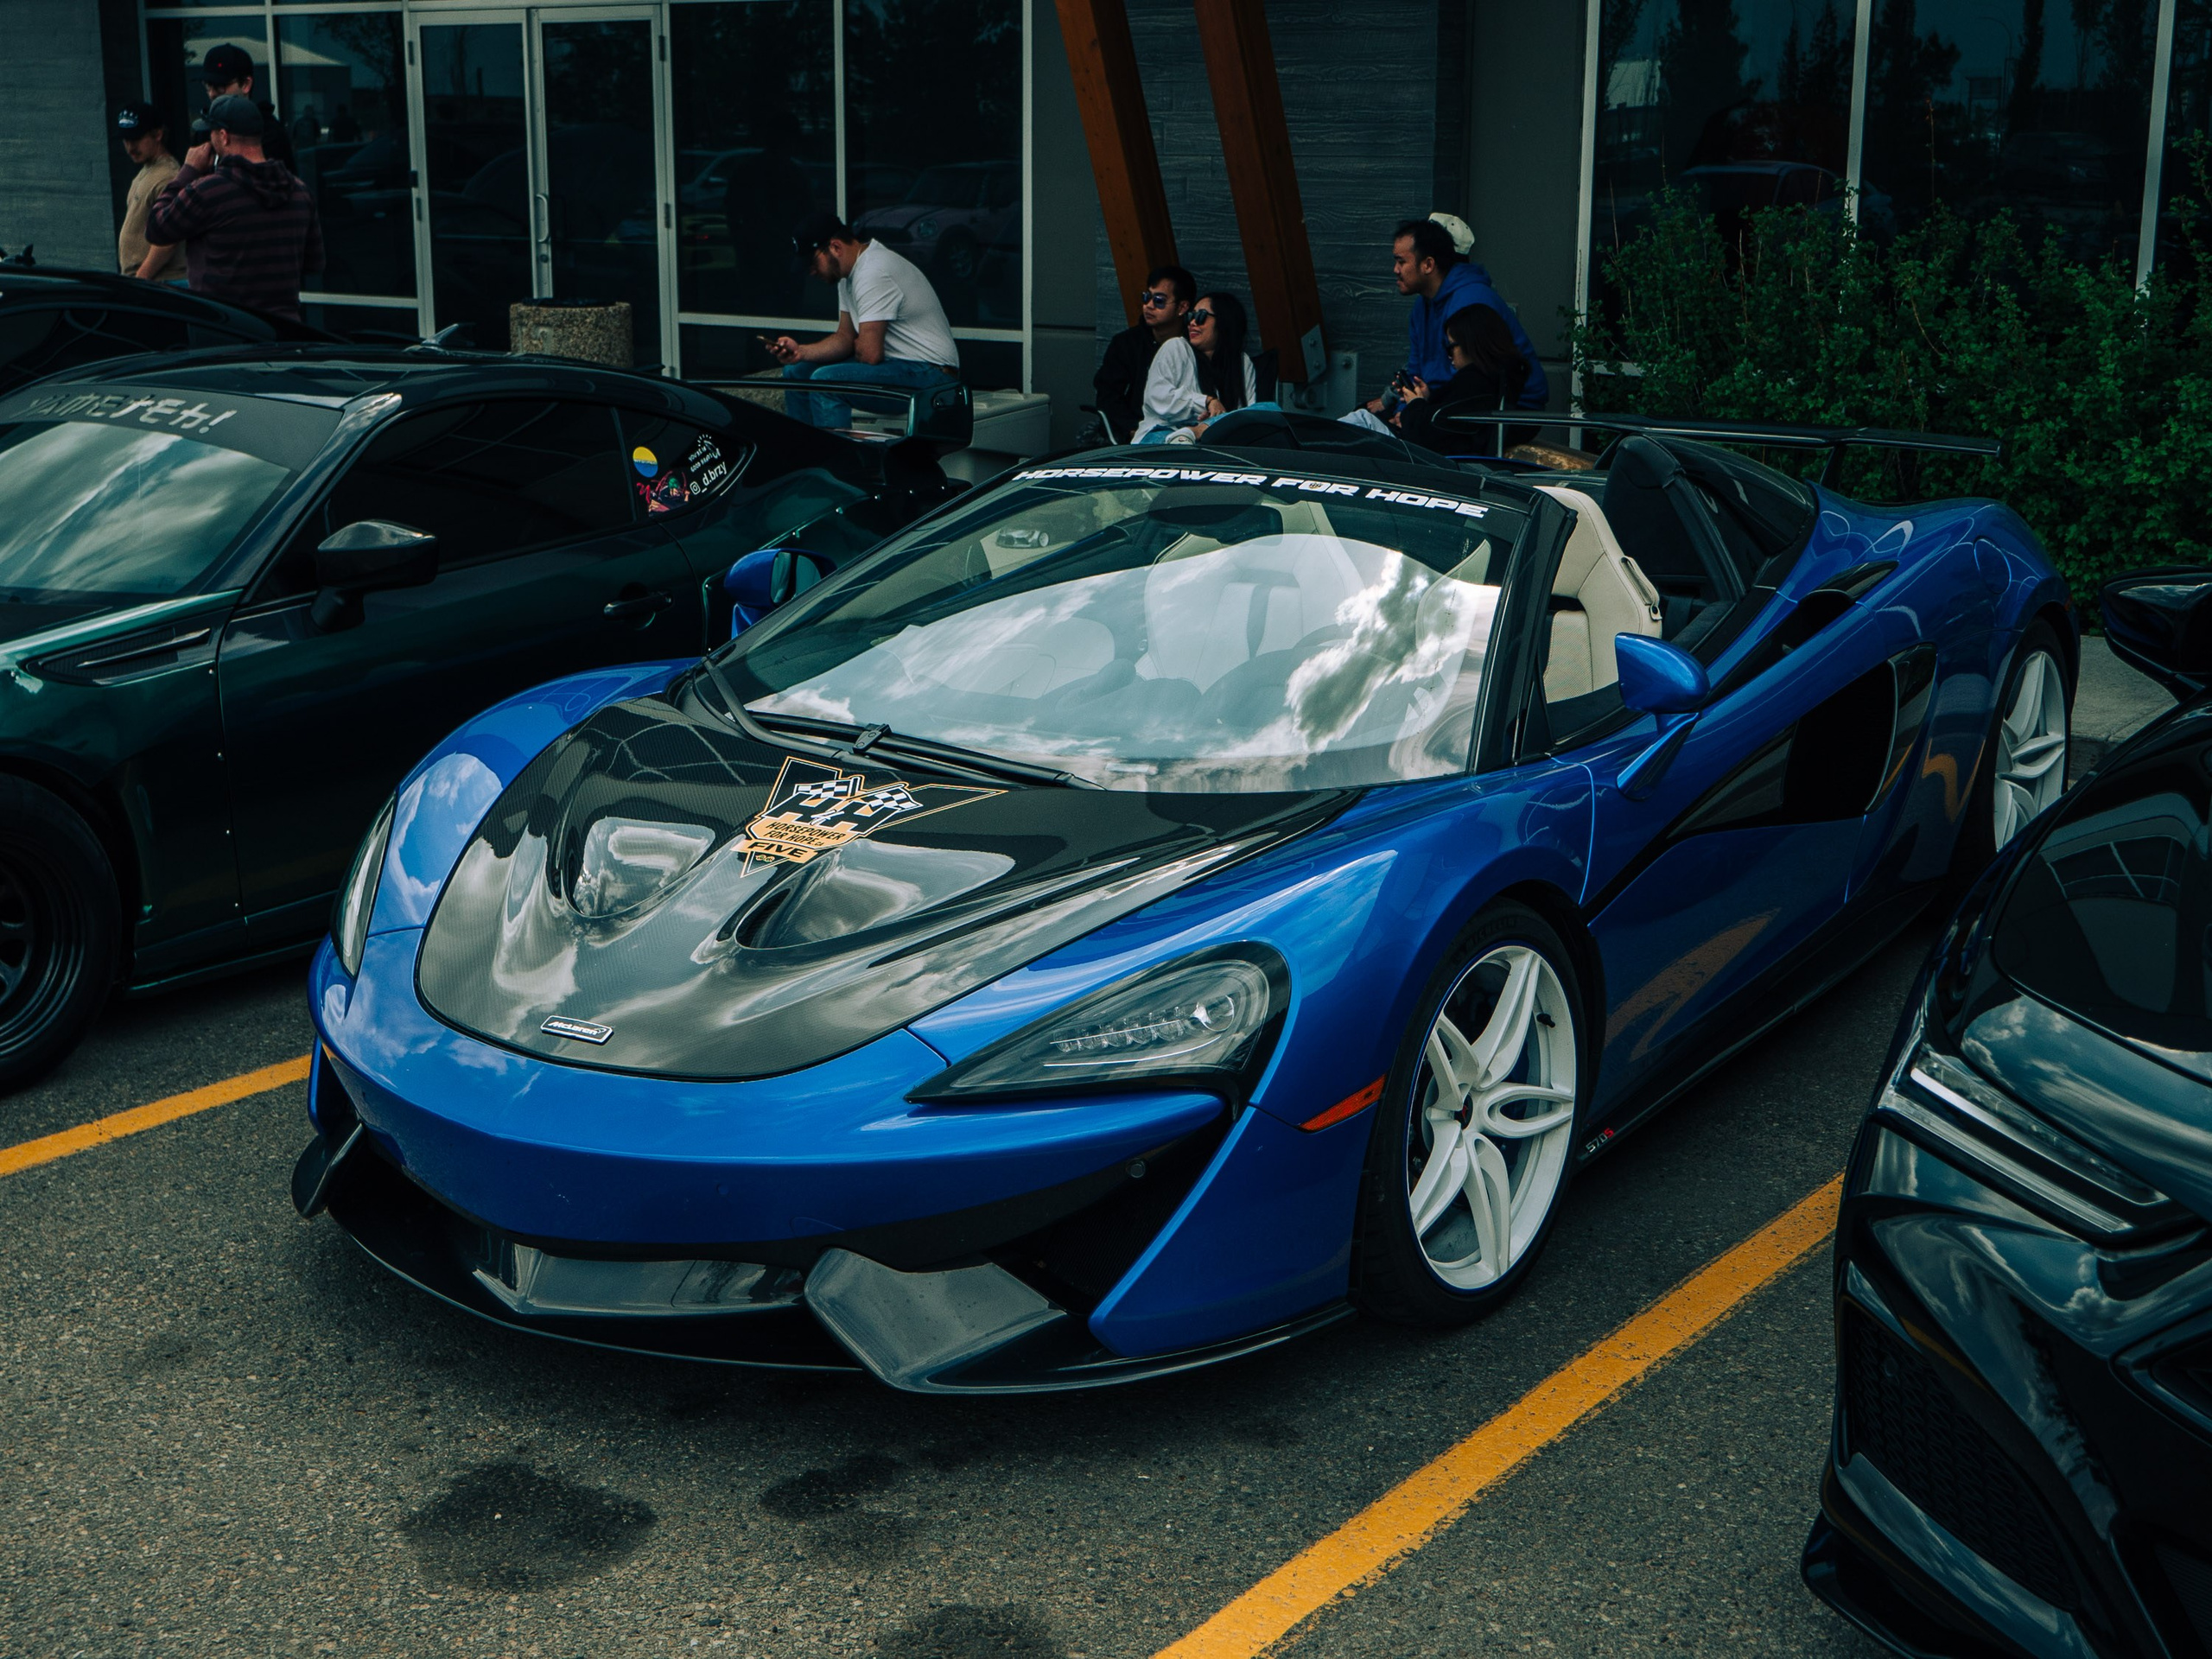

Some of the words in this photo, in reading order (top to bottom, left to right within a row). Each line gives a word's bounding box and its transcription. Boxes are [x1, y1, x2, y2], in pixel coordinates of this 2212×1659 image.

[1012, 467, 1268, 486] HORSEPOWER
[1271, 477, 1360, 497] FOR
[1365, 487, 1489, 518] HOPE
[763, 830, 788, 841] FOR
[766, 821, 847, 842] HORSEPOWER
[747, 842, 808, 858] FIVE
[547, 1021, 599, 1035] McLaren
[1585, 1128, 1614, 1154] 570S
